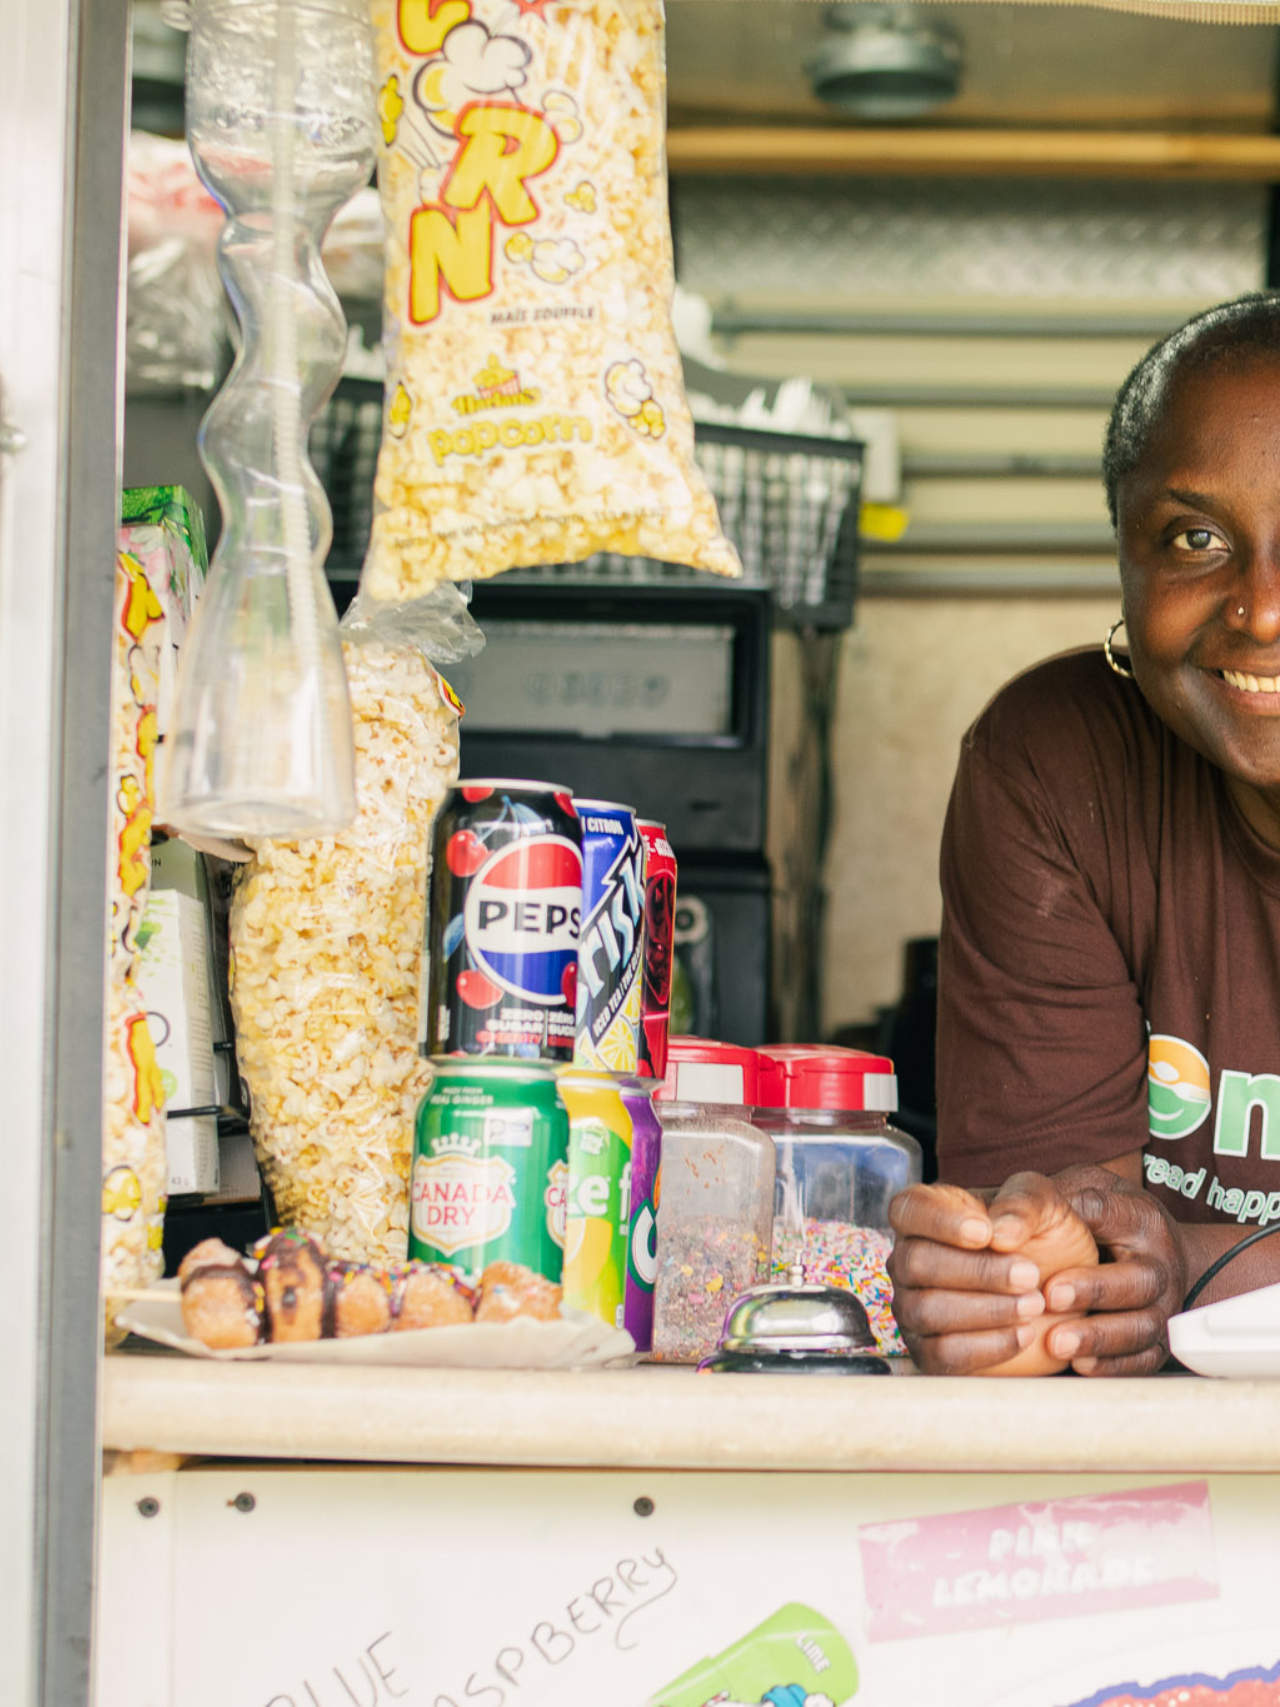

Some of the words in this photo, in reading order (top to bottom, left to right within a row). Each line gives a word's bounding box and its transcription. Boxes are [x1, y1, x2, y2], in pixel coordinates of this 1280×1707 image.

[426, 414, 594, 468] popcorn
[587, 817, 624, 835] CITRON
[478, 900, 581, 940] PEPS
[501, 1008, 544, 1021] ZERO
[591, 1006, 613, 1038] ICED
[486, 1020, 543, 1033] SUGAR
[548, 1023, 576, 1037] SUC
[452, 1095, 494, 1105] GINGER
[411, 1182, 511, 1204] CANADA
[427, 1205, 477, 1226] DRY
[988, 1520, 1096, 1561] PINK
[932, 1556, 1156, 1608] LEMONADE
[796, 1631, 831, 1674] LIME
